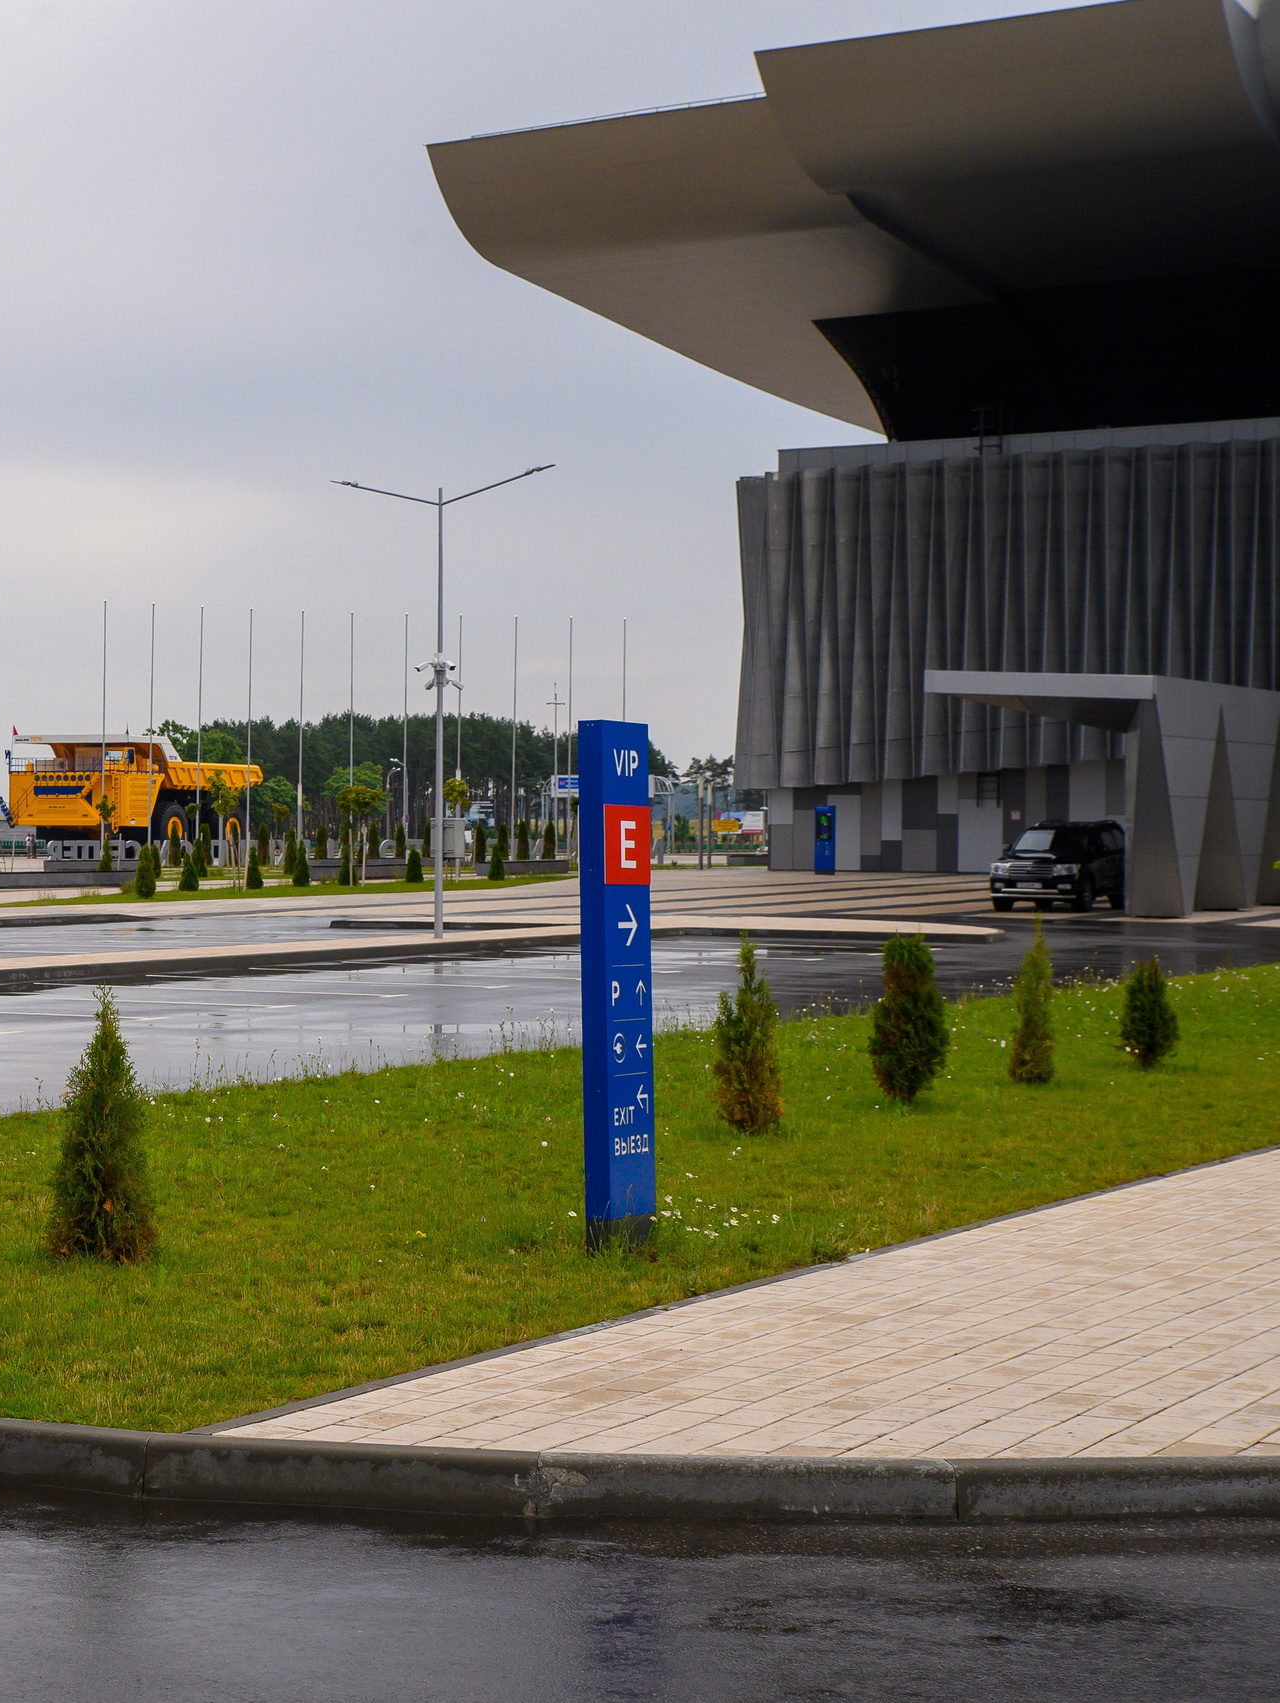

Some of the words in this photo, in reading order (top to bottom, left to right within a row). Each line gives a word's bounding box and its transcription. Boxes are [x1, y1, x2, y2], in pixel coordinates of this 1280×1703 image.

[613, 748, 639, 777] VIP
[620, 820, 637, 869] E
[611, 980, 621, 1007] P
[613, 1105, 635, 1127] EXIT
[614, 1133, 650, 1157] ВЫЕЗД
